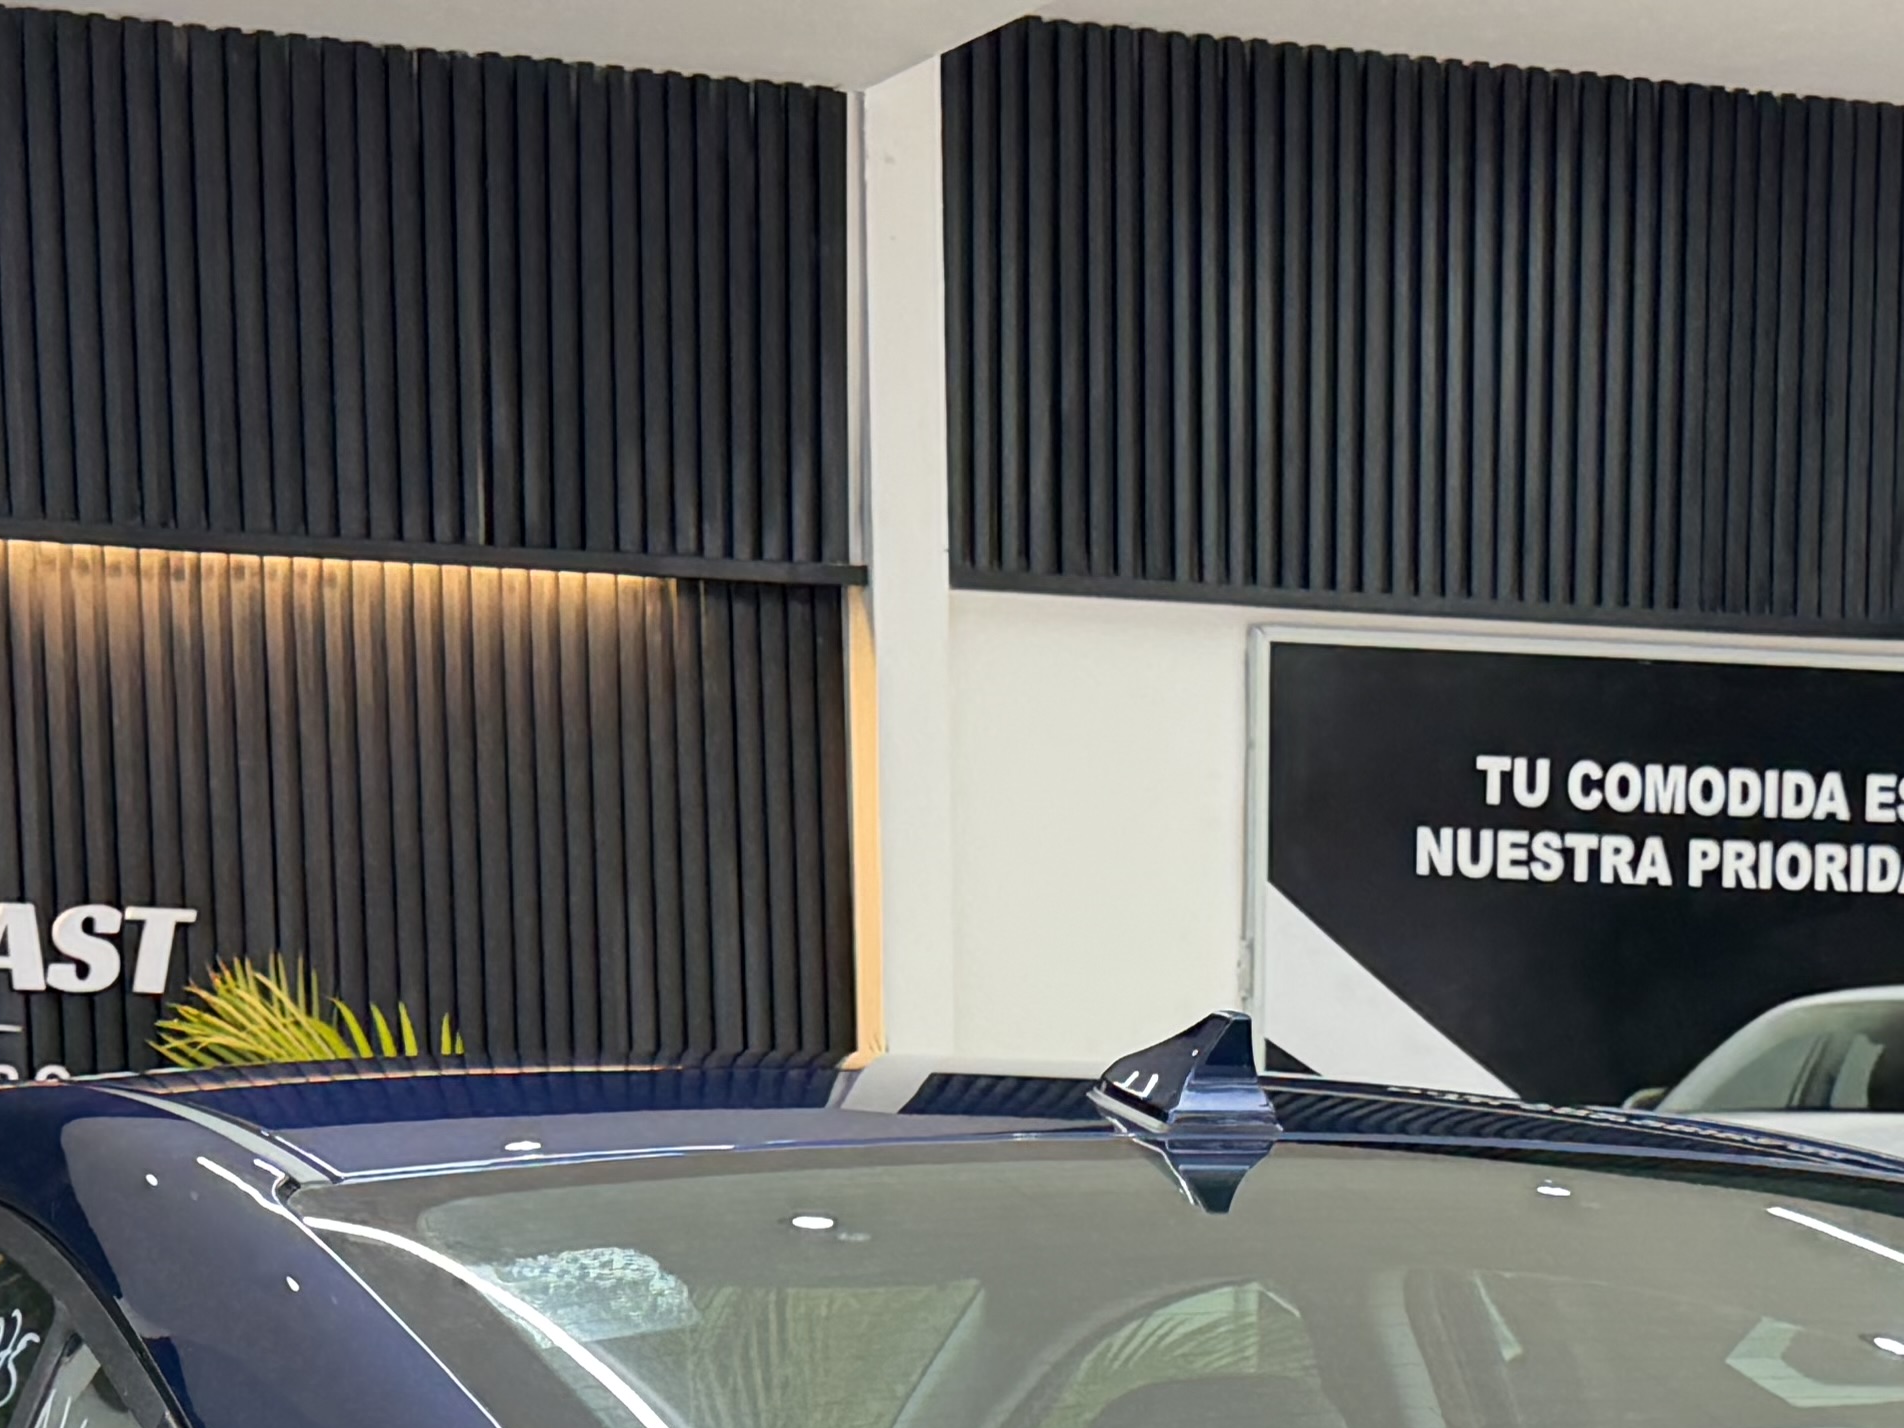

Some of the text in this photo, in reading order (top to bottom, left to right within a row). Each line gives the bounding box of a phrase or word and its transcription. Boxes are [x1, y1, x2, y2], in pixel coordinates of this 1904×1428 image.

[1476, 755, 1551, 808] TU
[1567, 759, 1851, 822] COMODIDA
[1415, 826, 1673, 887] NUESTRA
